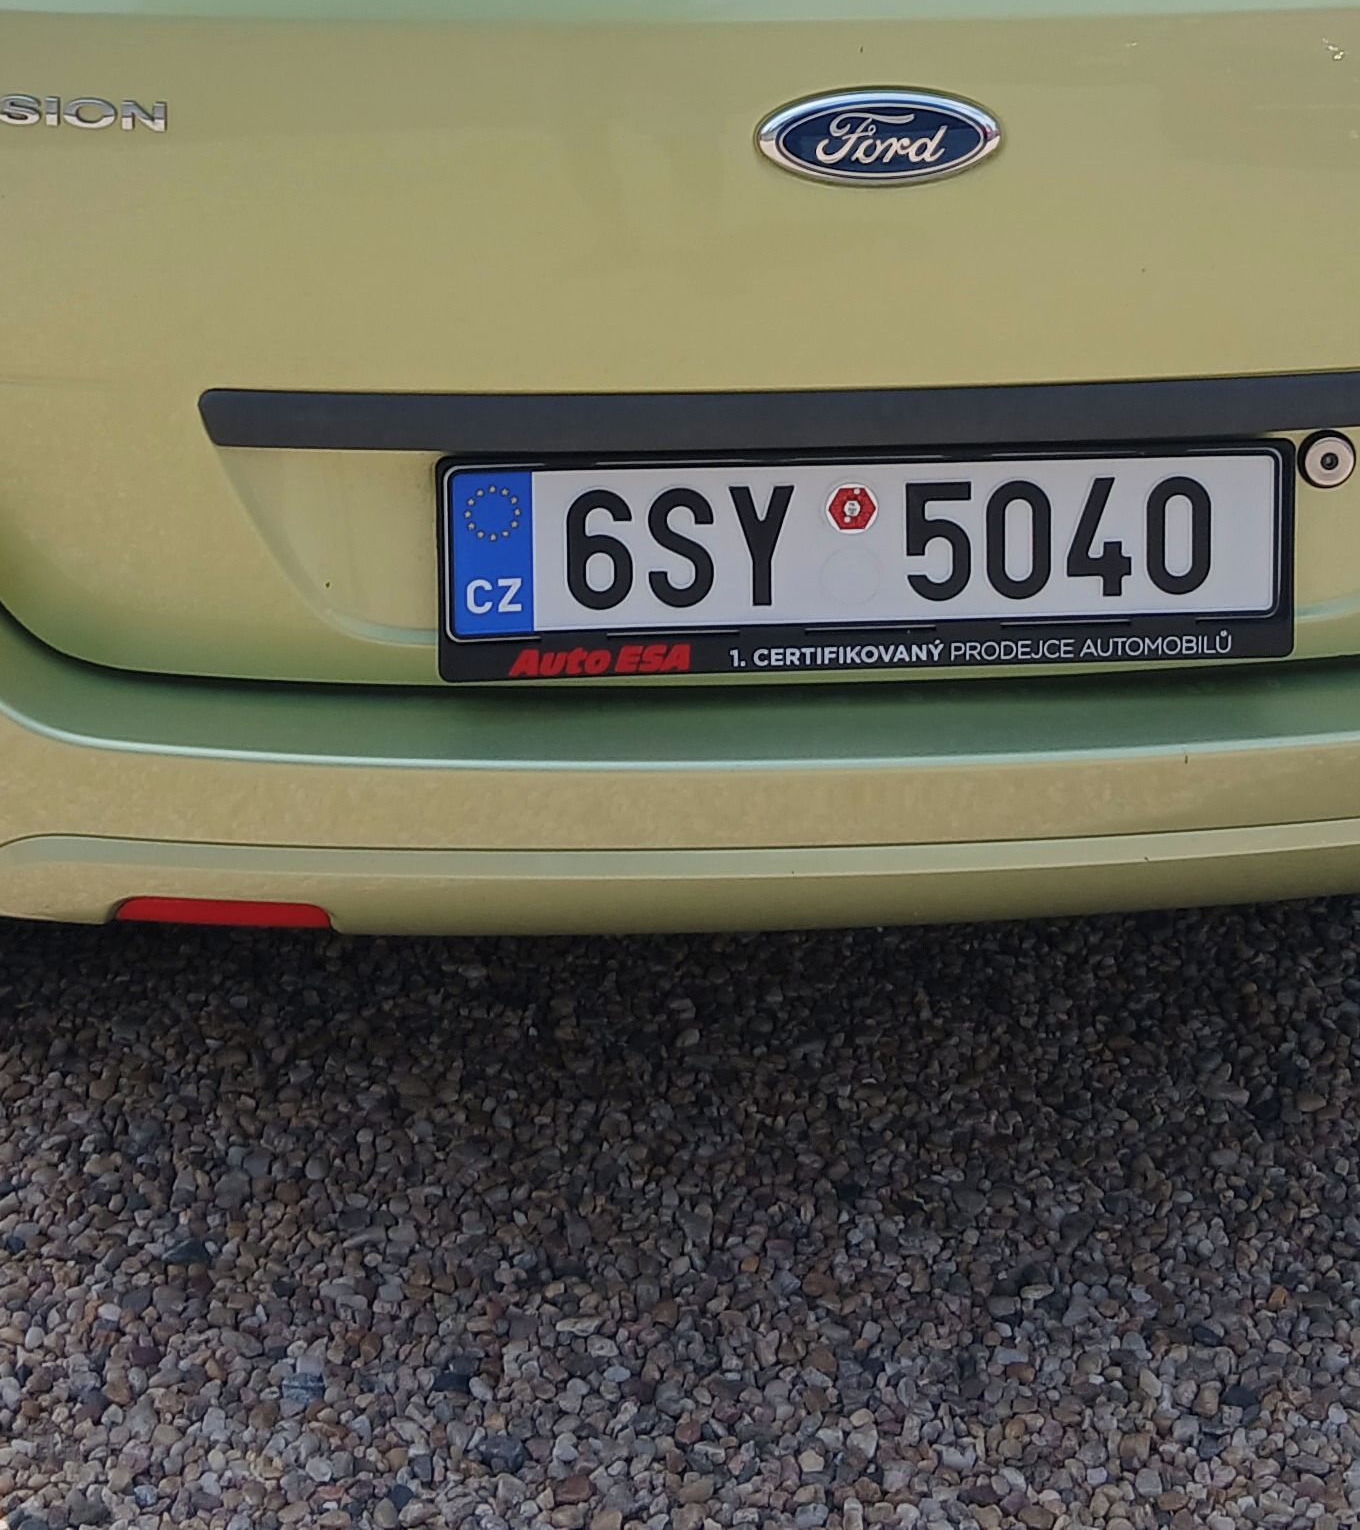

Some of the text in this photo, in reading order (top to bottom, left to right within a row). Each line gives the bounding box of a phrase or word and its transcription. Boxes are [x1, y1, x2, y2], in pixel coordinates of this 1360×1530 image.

[814, 111, 948, 165] Ford
[565, 476, 1213, 611] 6SY 5040
[465, 577, 522, 614] CZ
[508, 643, 692, 677] Auto ESA
[729, 630, 1233, 667] 1. CERTIFIKOVANÝ PRODEJCE AUTOMOBILŮ
